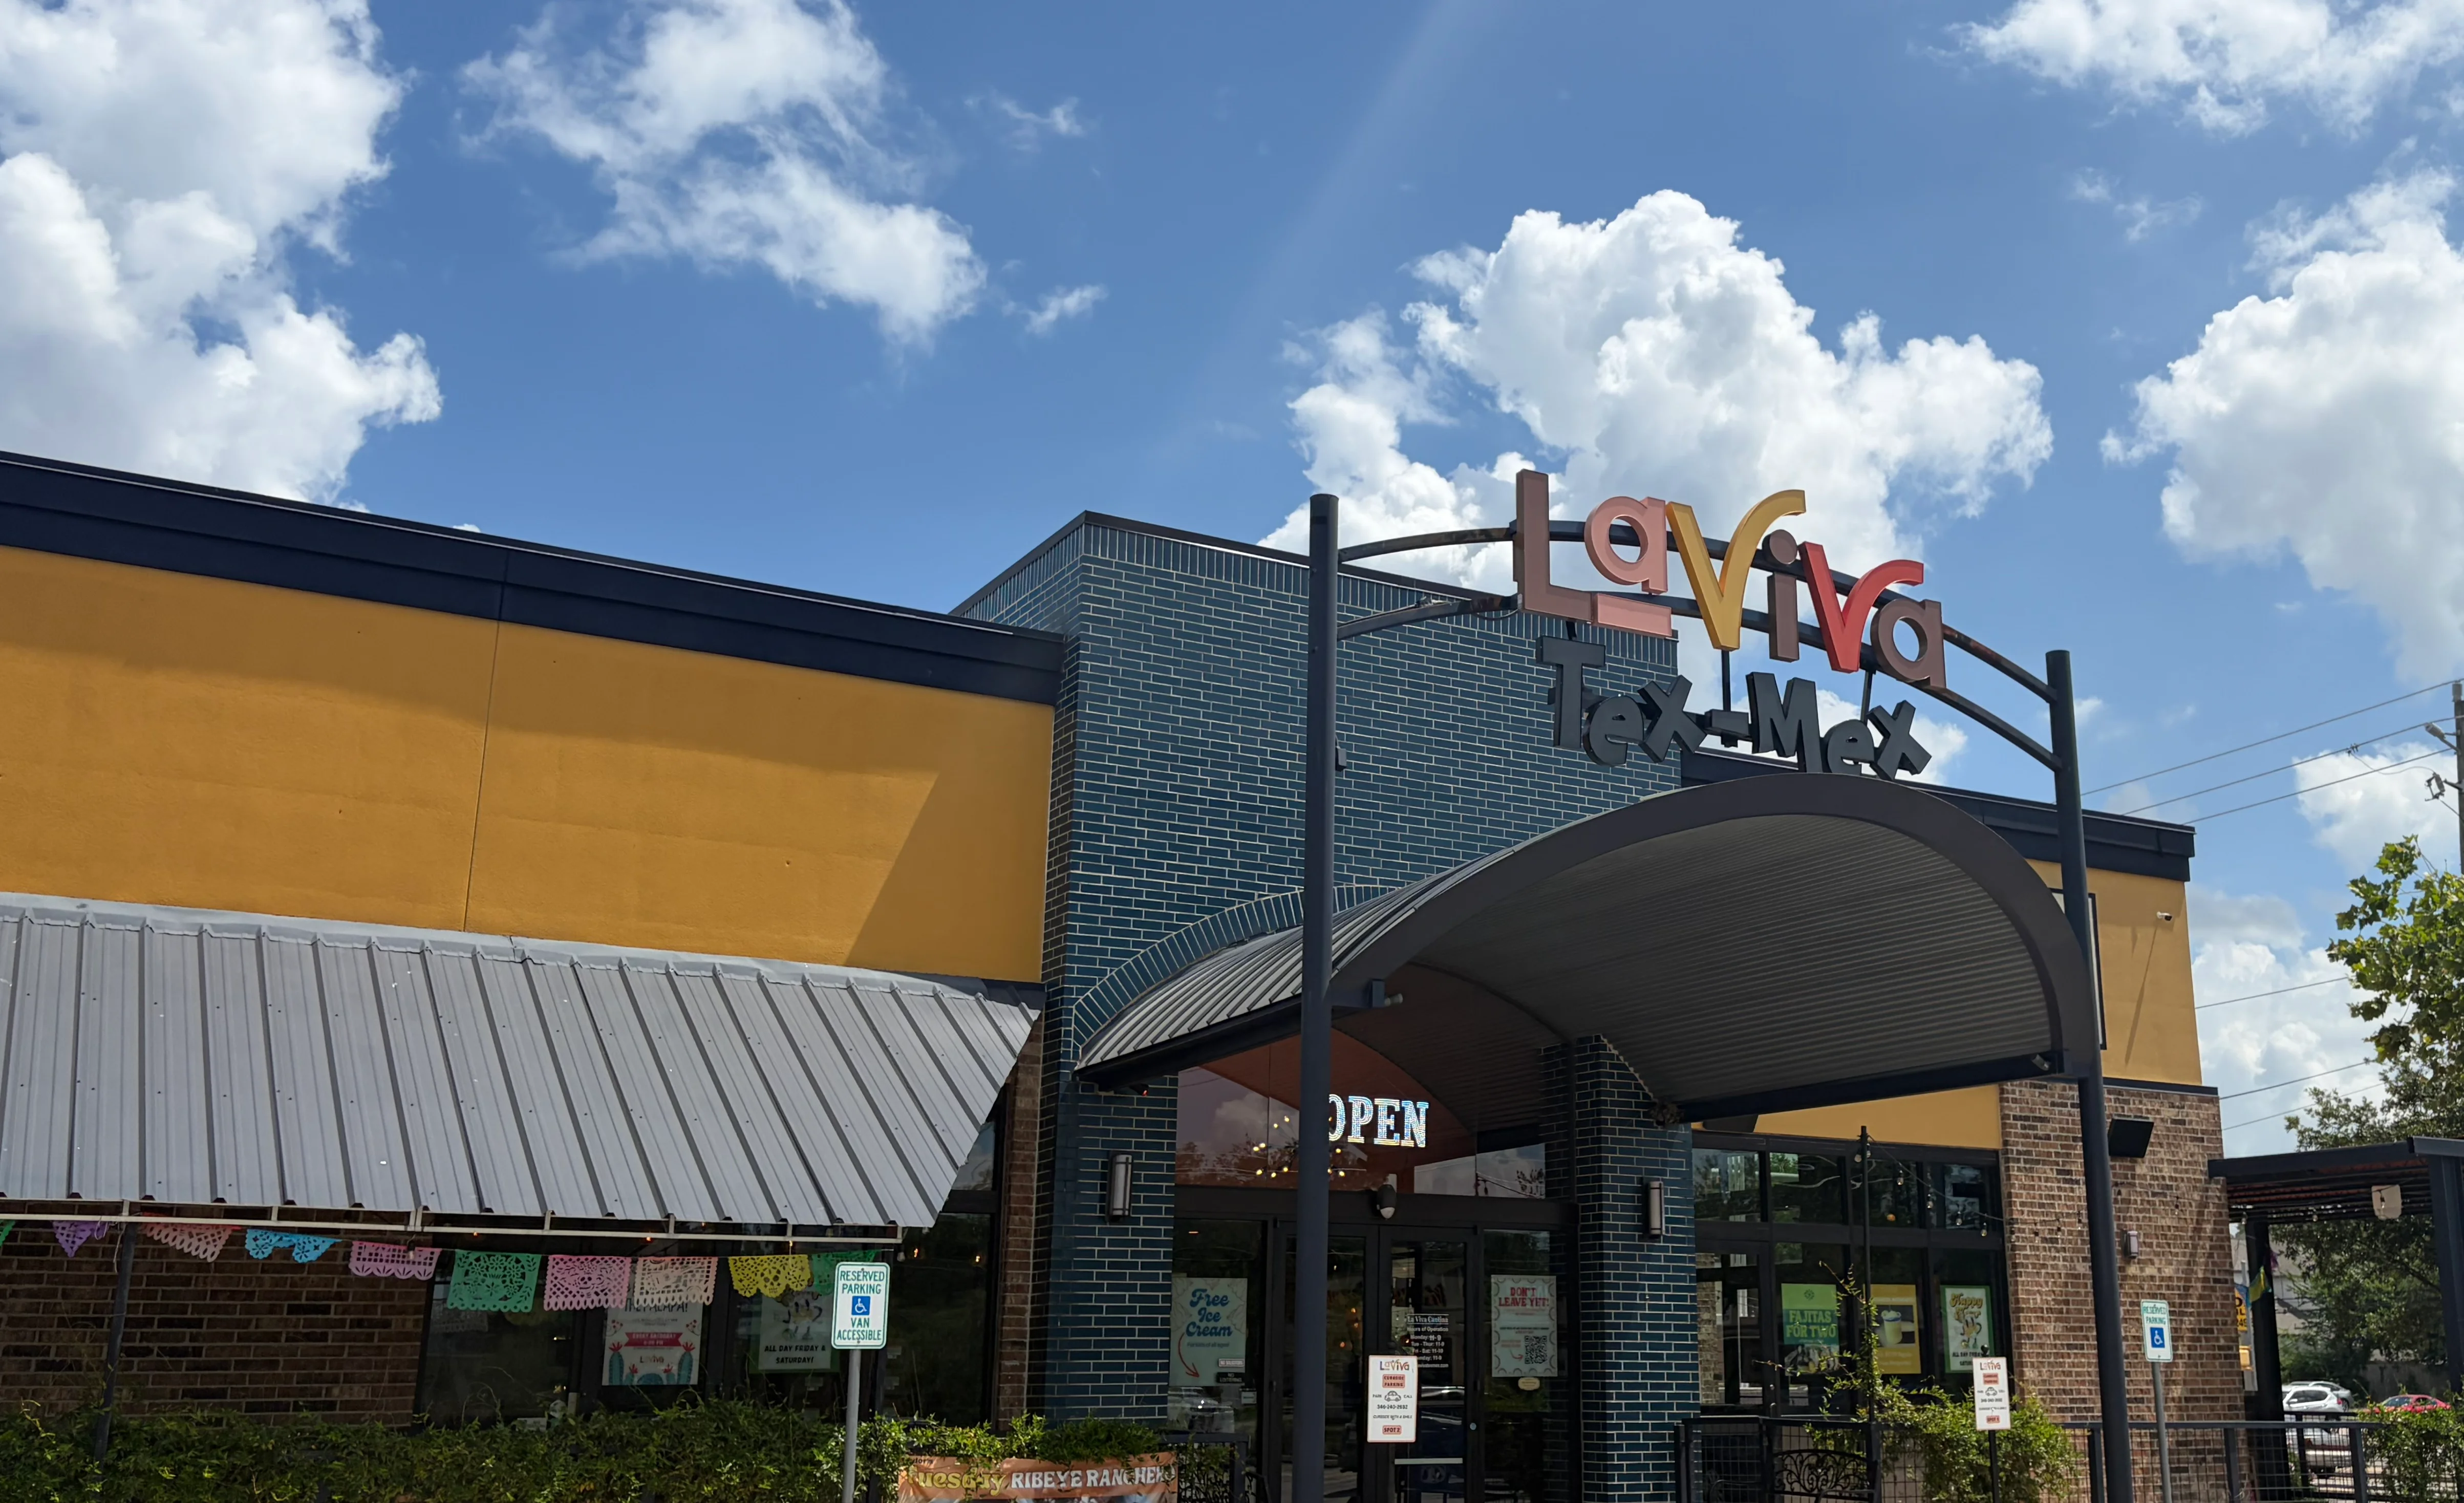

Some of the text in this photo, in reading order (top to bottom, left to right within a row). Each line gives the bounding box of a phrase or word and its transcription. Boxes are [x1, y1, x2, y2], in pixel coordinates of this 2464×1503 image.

[1536, 635, 1932, 780] Tex-Mex
[1329, 1094, 1429, 1148] OPEN
[840, 1271, 885, 1281] RESERVED
[842, 1283, 881, 1294] PARKING
[1510, 1287, 1536, 1297] DON'T
[1190, 1289, 1230, 1307] Free
[1499, 1297, 1549, 1307] LEAVE YET!
[1949, 1293, 1983, 1309] Happy
[1198, 1307, 1222, 1322] Ice
[1789, 1311, 1832, 1323] FAJITAS
[2145, 1316, 2166, 1325] PARKING
[851, 1318, 870, 1328] VAN
[1186, 1322, 1233, 1337] Cream
[837, 1329, 882, 1340] ACCESSIBLE
[1786, 1324, 1837, 1338] FOR TWO
[1011, 1470, 1082, 1489] RIBEYE
